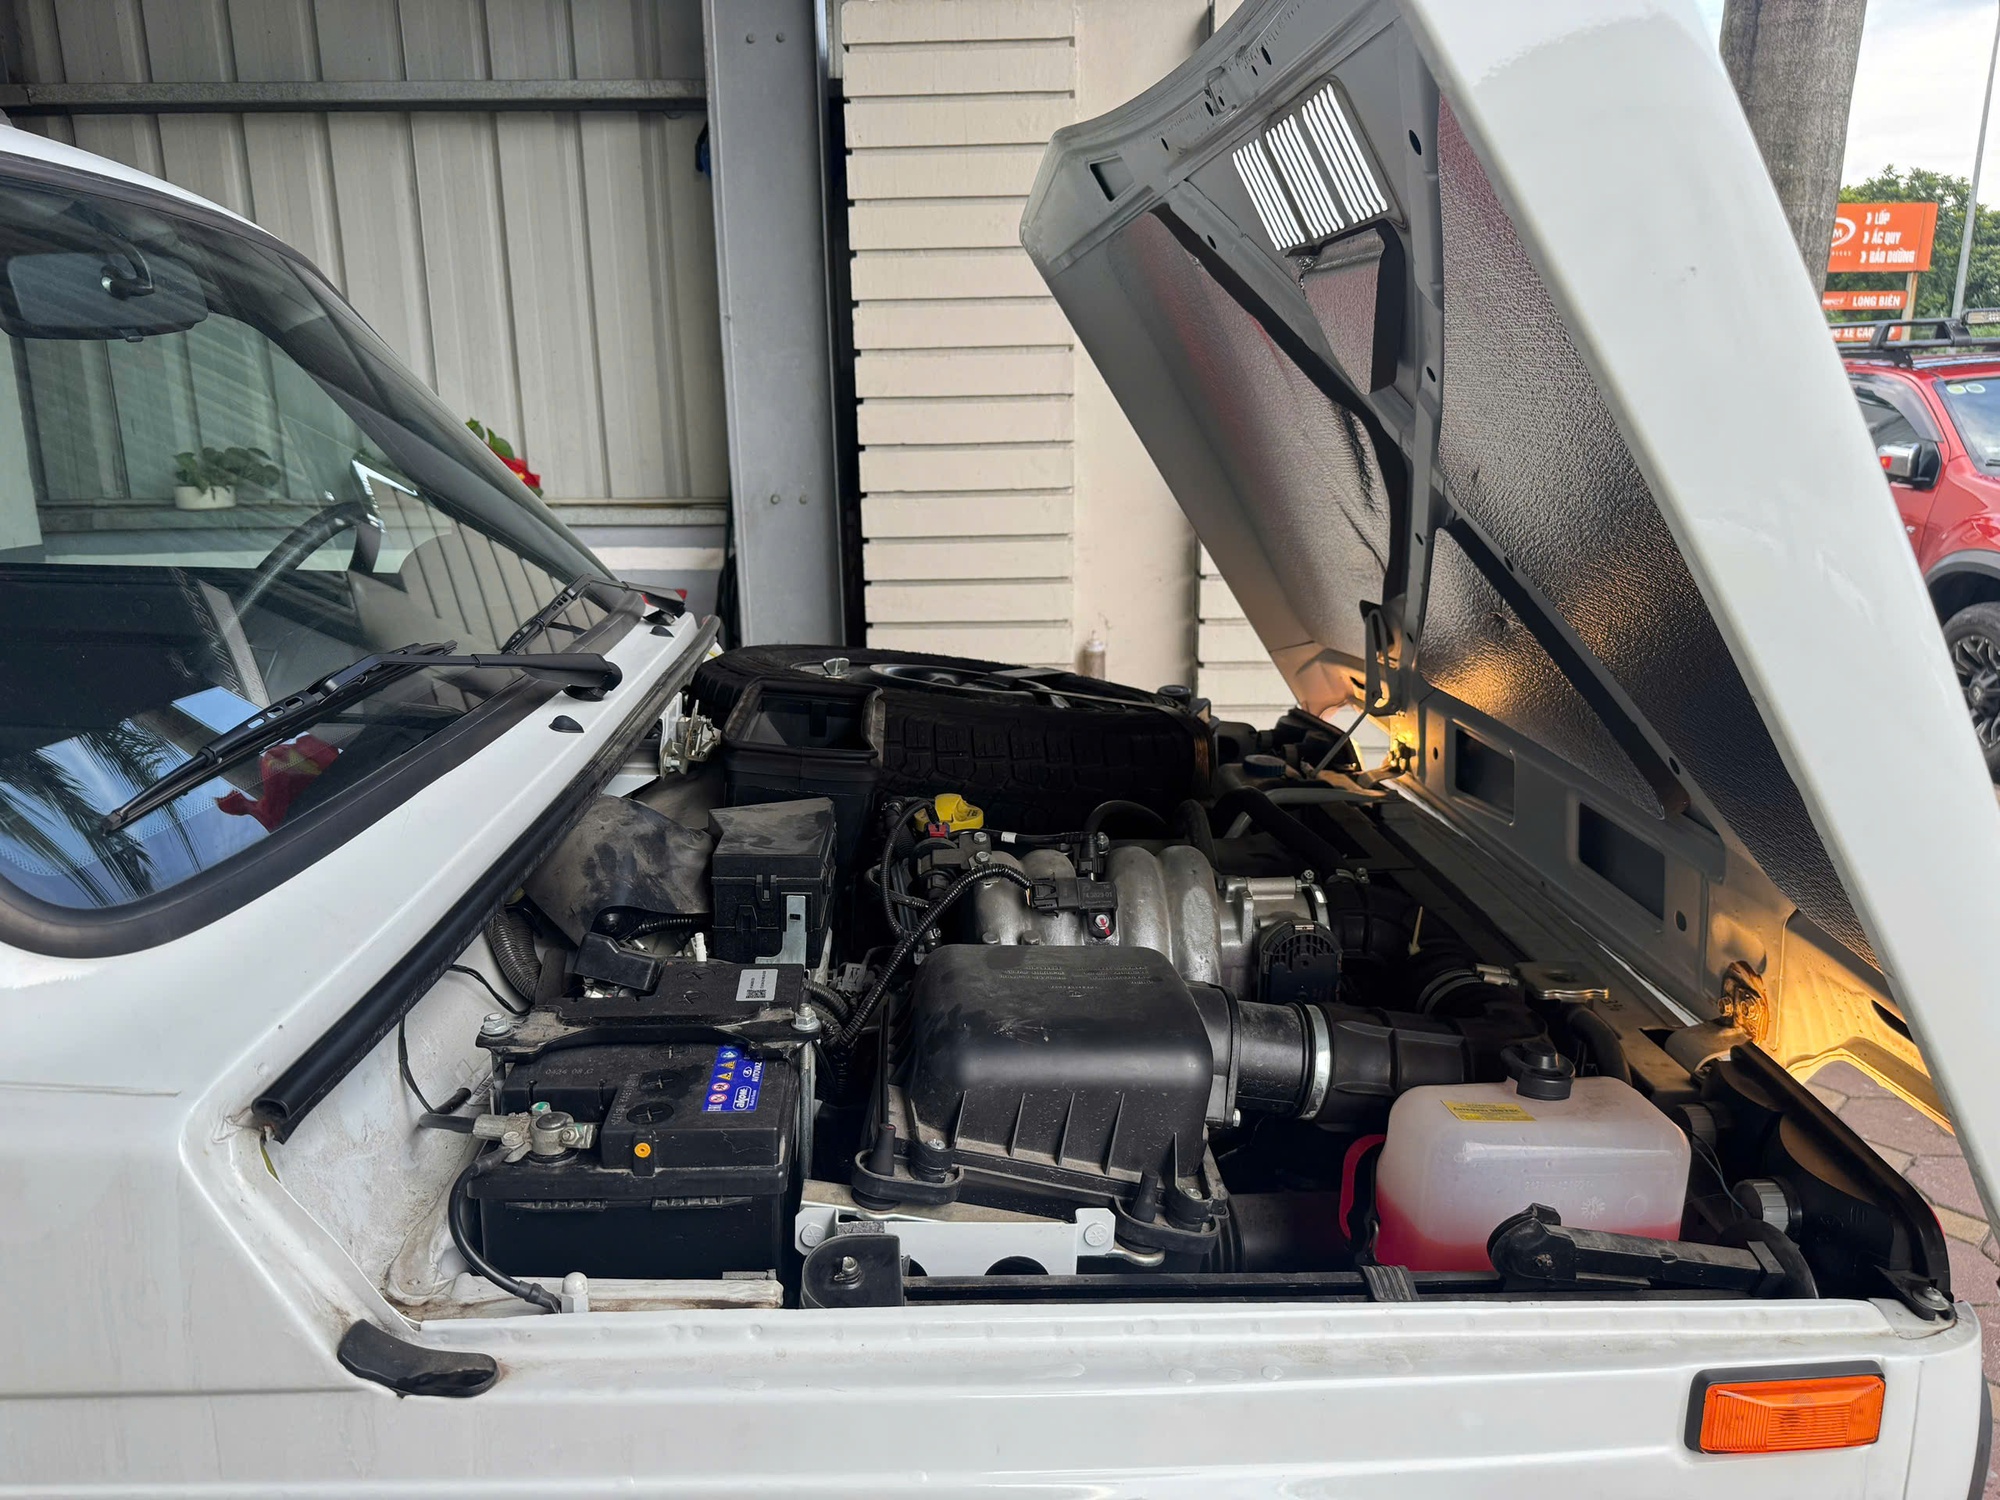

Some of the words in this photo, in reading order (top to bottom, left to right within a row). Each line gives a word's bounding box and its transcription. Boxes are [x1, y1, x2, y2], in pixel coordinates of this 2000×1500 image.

[1884, 231, 1902, 246] QUY
[1852, 296, 1877, 307] LONG
[1878, 294, 1901, 307] BIÊN
[1842, 327, 1855, 338] XE
